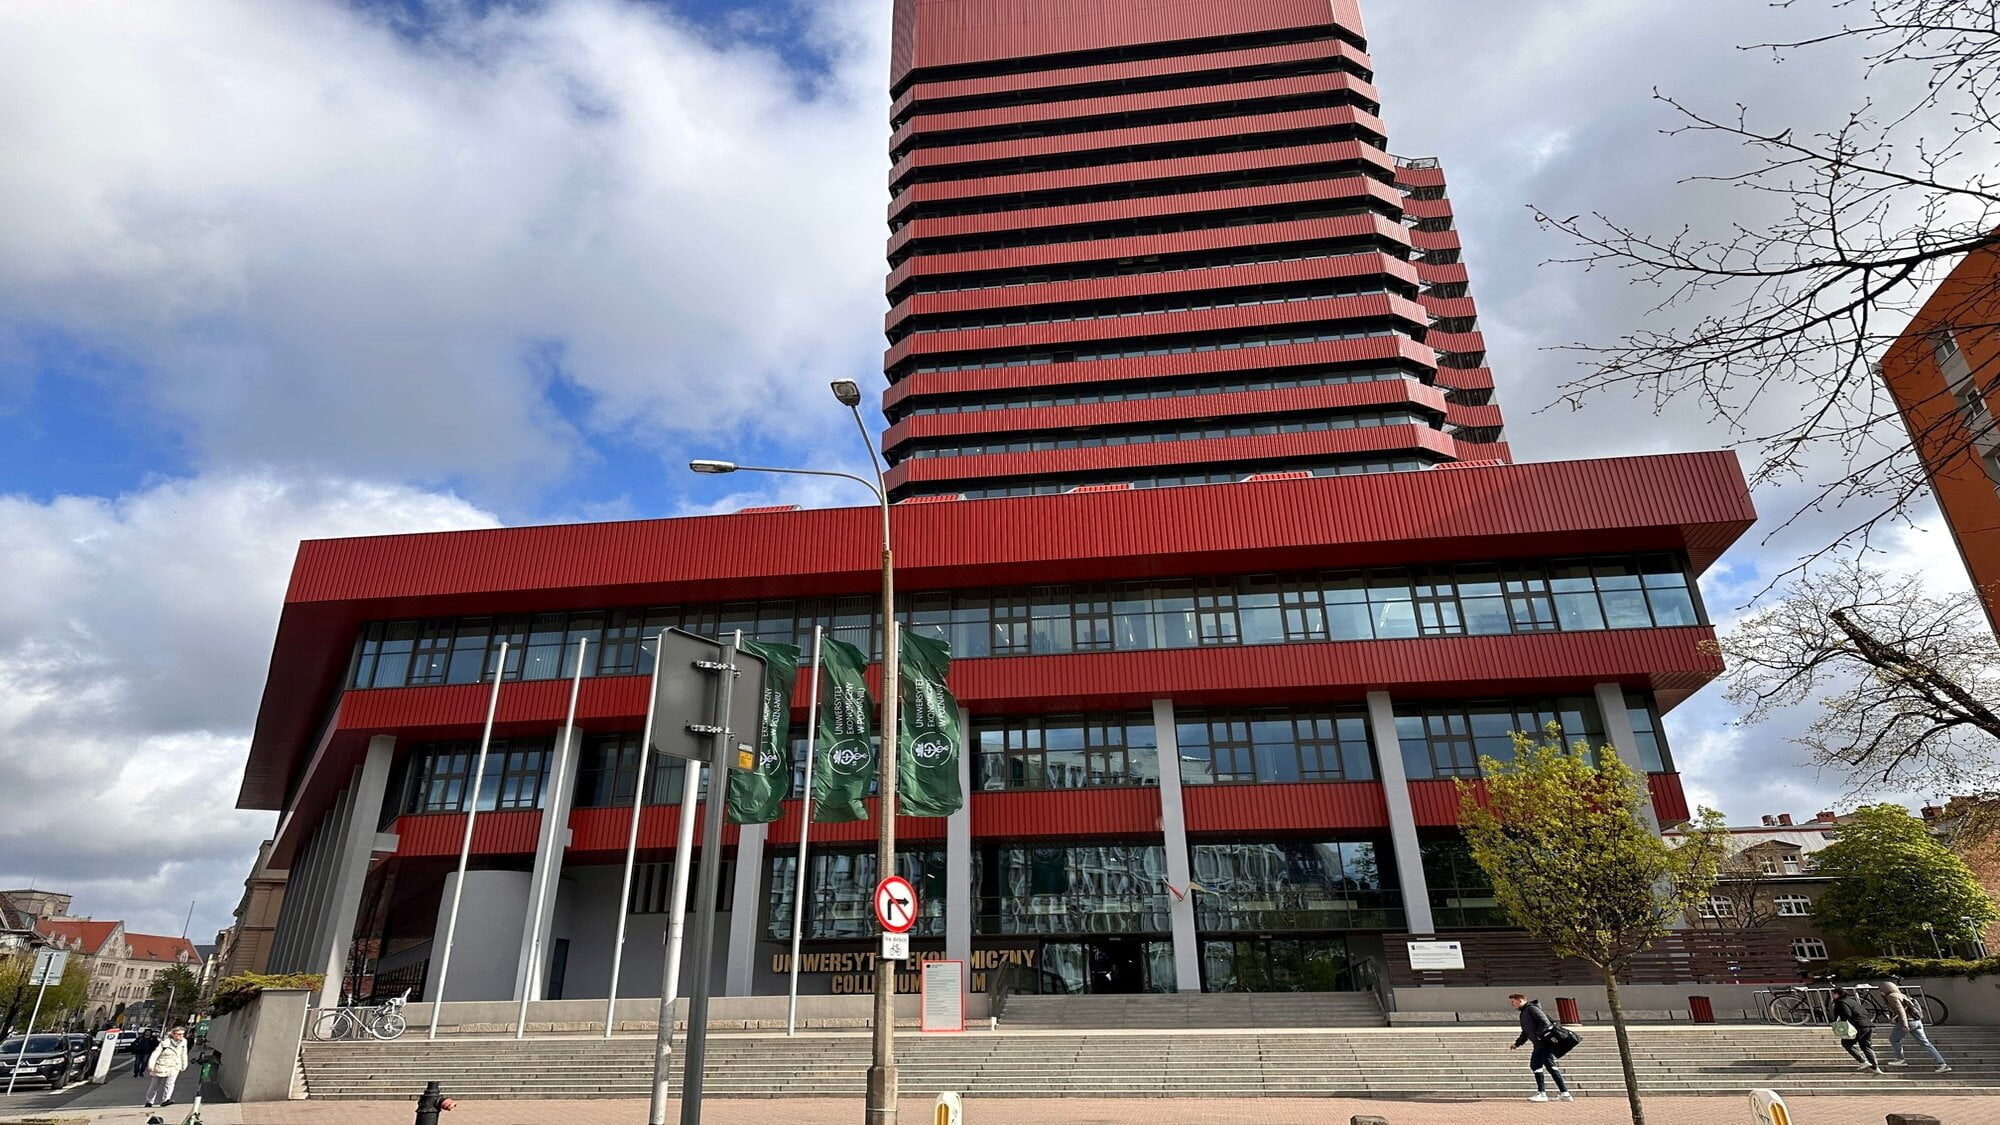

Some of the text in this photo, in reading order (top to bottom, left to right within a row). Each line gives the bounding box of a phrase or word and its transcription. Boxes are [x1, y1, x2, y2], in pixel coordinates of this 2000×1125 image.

[770, 692, 781, 727] POZNANIU
[834, 686, 843, 735] UNIWERSYTET
[845, 681, 855, 735] EKONOMICZNY
[857, 687, 865, 734] W POZNANIU
[915, 679, 924, 728] UNIWERSYTET
[938, 720, 946, 728] W
